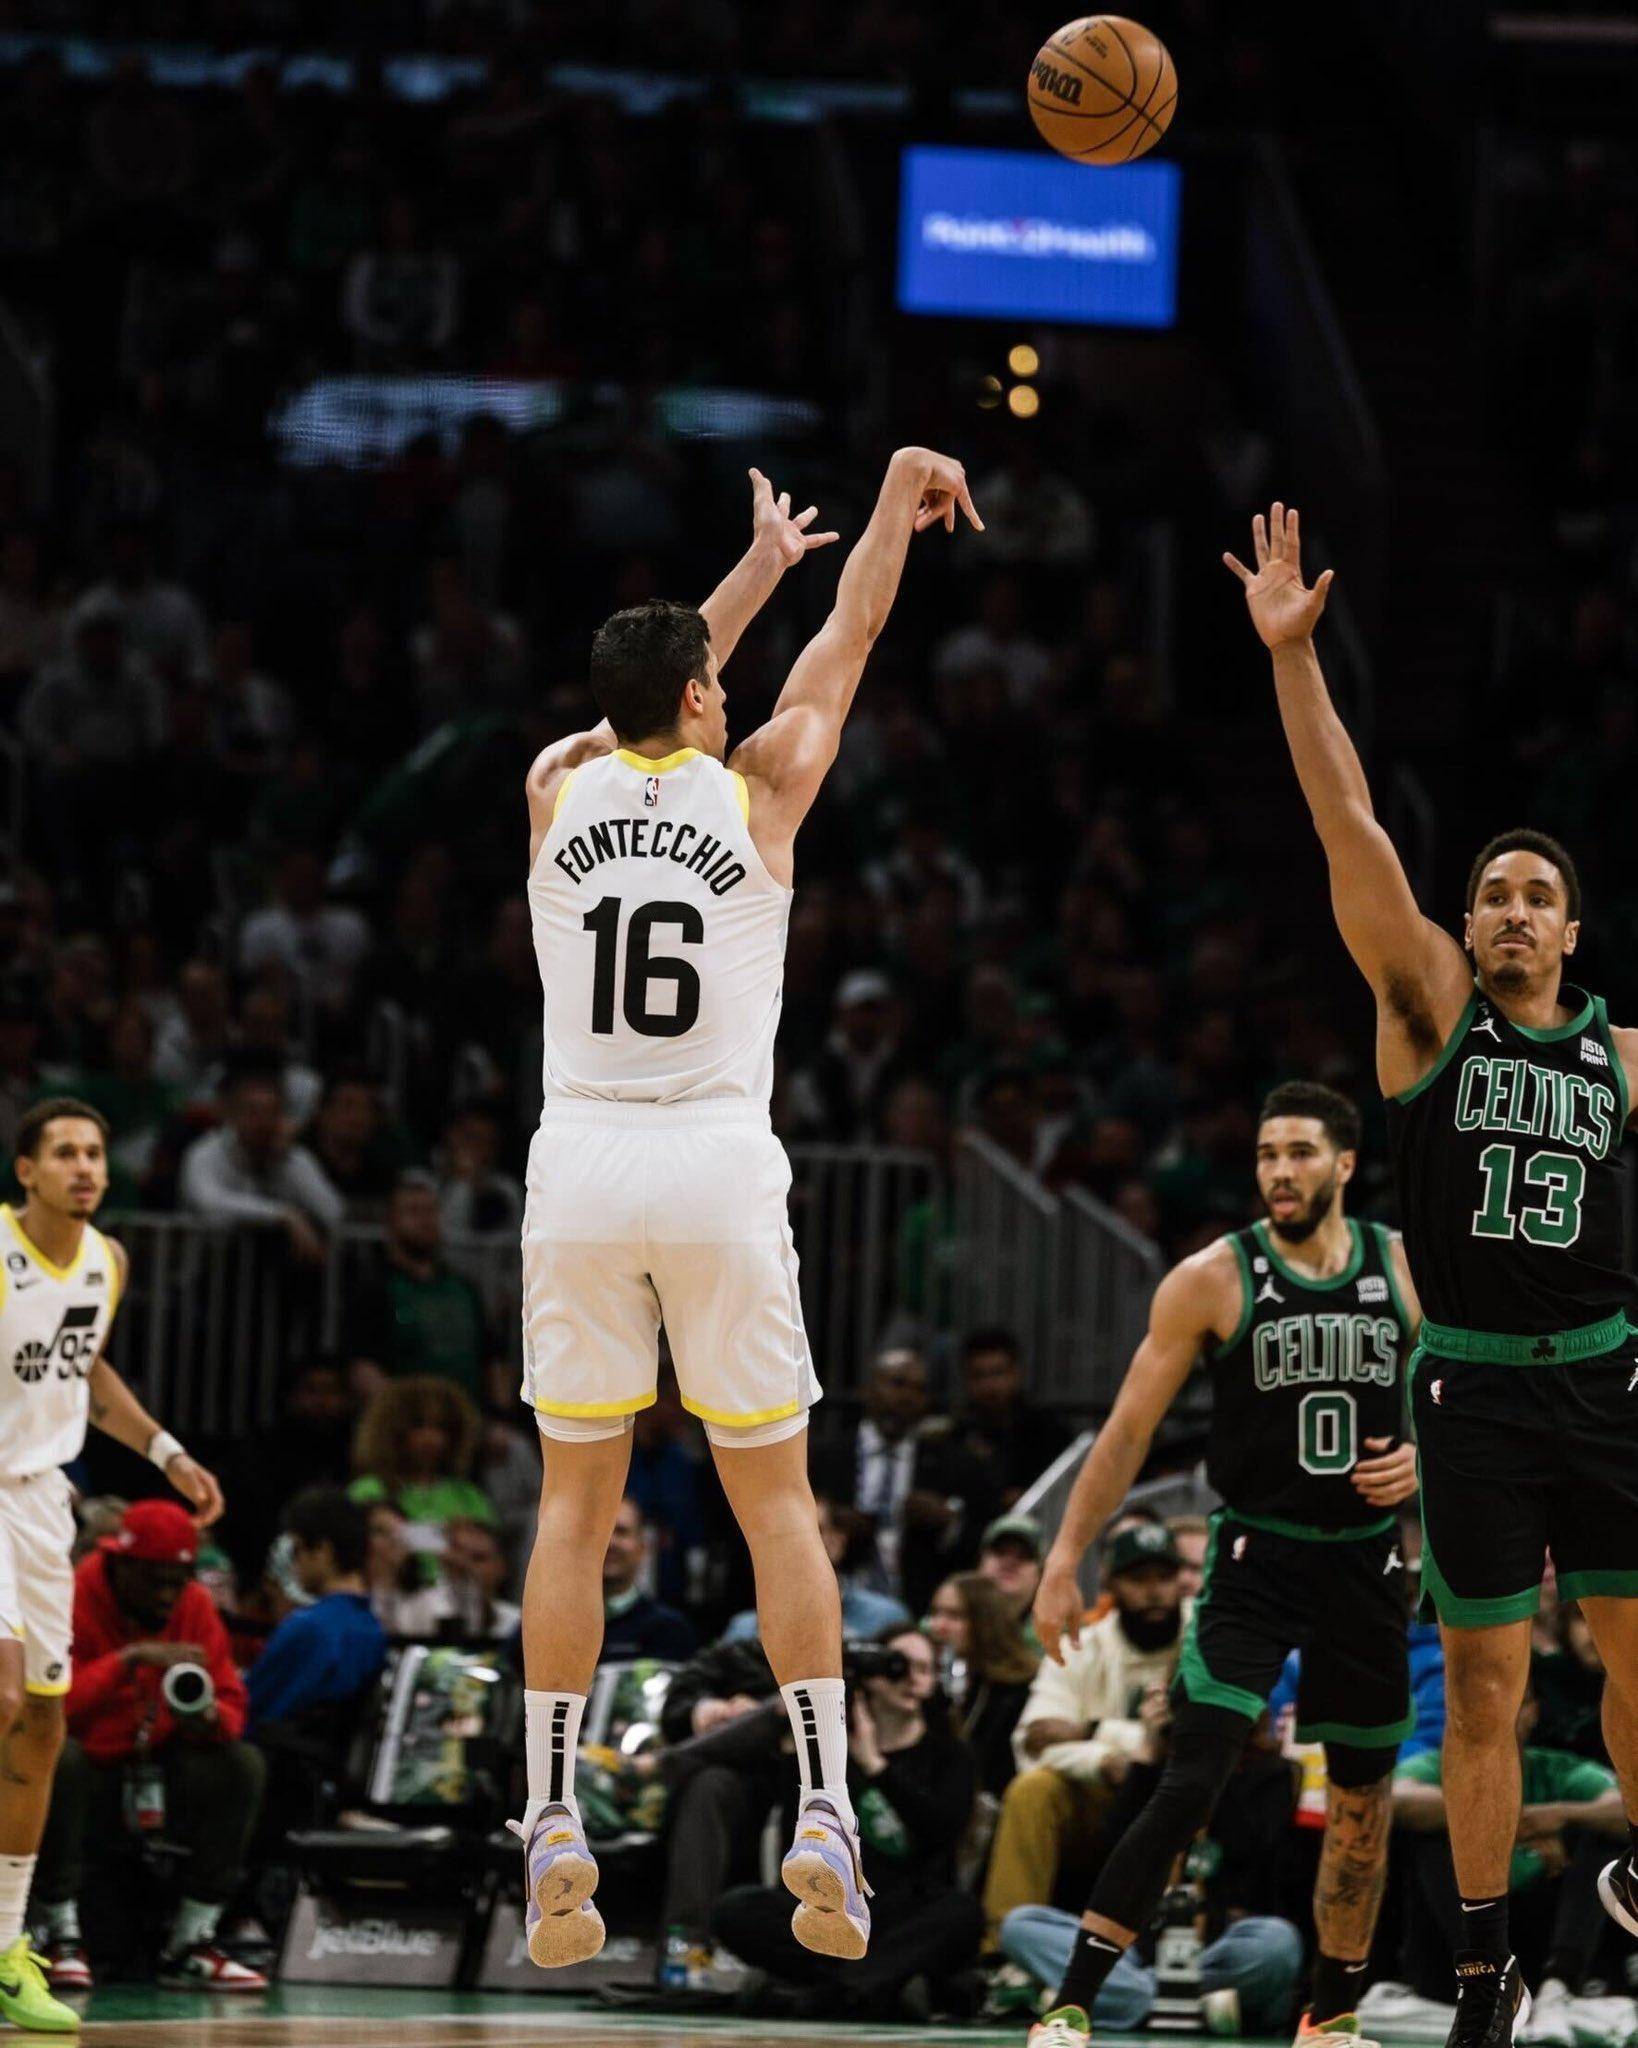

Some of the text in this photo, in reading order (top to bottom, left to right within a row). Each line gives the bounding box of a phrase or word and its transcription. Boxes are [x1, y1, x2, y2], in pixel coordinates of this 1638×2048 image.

[554, 819, 746, 896] FONTECCHIO
[583, 896, 704, 1037] 16
[1581, 1036, 1607, 1058] VISTA
[1455, 1056, 1614, 1160] CELTICS
[1471, 1143, 1586, 1248] 13
[1253, 1313, 1399, 1391] CELTICS
[1298, 1390, 1357, 1475] 0
